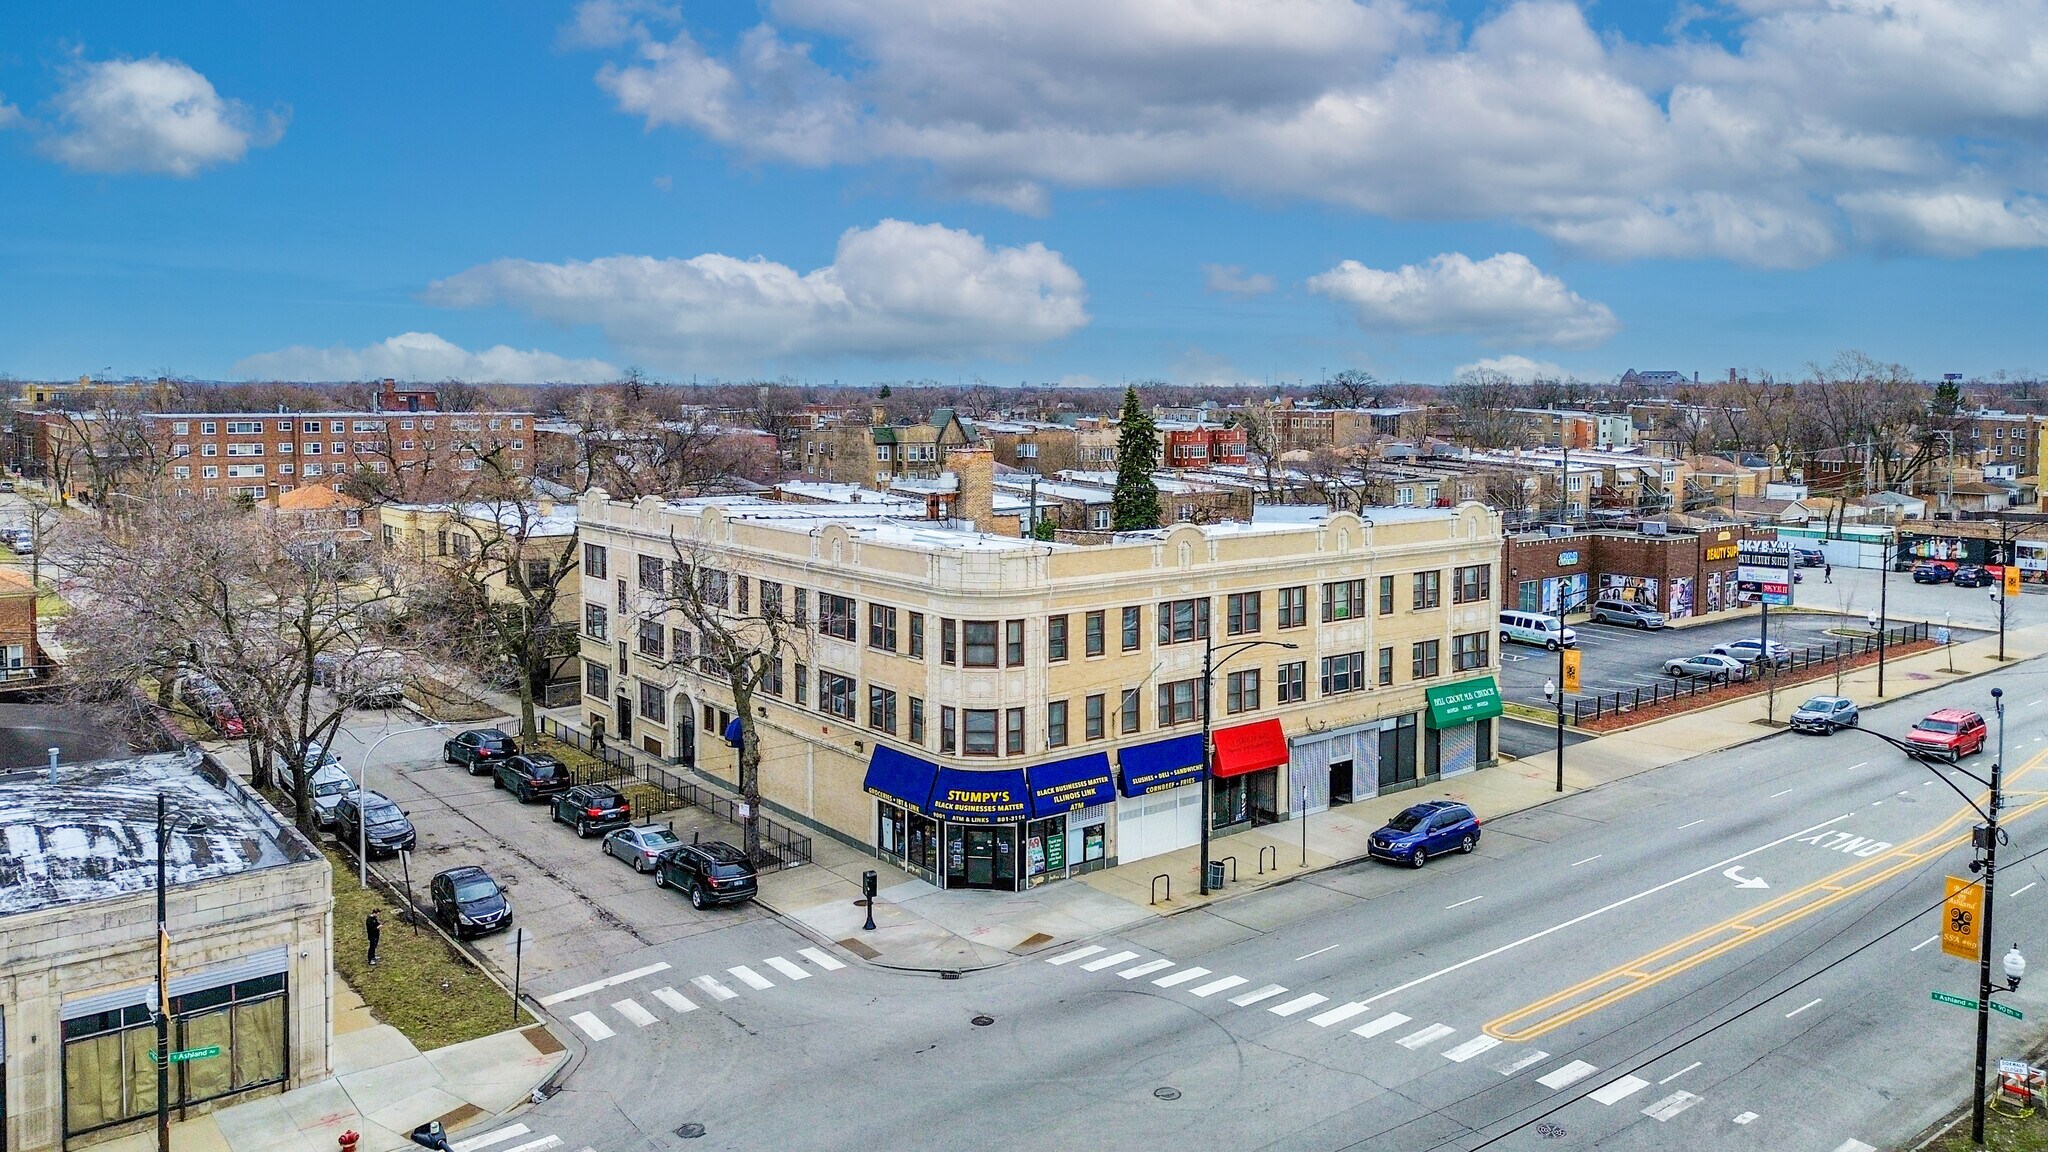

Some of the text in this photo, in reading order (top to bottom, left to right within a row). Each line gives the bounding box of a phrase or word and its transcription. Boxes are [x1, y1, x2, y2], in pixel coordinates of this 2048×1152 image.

[1707, 547, 1726, 560] BEAUTY
[1739, 555, 1788, 566] SKYE LUXURY SUITES
[1434, 698, 1445, 706] BELL
[1446, 694, 1464, 704] GROVE
[1474, 688, 1494, 698] CHURCH
[1132, 774, 1154, 785] SLUSHES
[1158, 771, 1170, 779] DELI
[1037, 776, 1109, 797] BLACK BUSINESSES MATTER
[1146, 777, 1195, 794] CORNBEEF FRIES
[868, 787, 892, 802] GROCERIES
[908, 802, 920, 812] LINK
[947, 790, 1010, 803] STUMPY'S
[1054, 788, 1096, 803] ILLINOIS LINK
[934, 800, 1024, 812] BLACK BUSINESSES MATTER
[1070, 801, 1084, 811] ATM
[1797, 830, 1893, 857] ONLY
[1948, 897, 1977, 910] Ashland
[1944, 933, 1960, 943] SSA
[1940, 995, 1966, 1006] Ashland
[1998, 1004, 2014, 1015] 90th
[178, 1050, 208, 1060] Ashland
